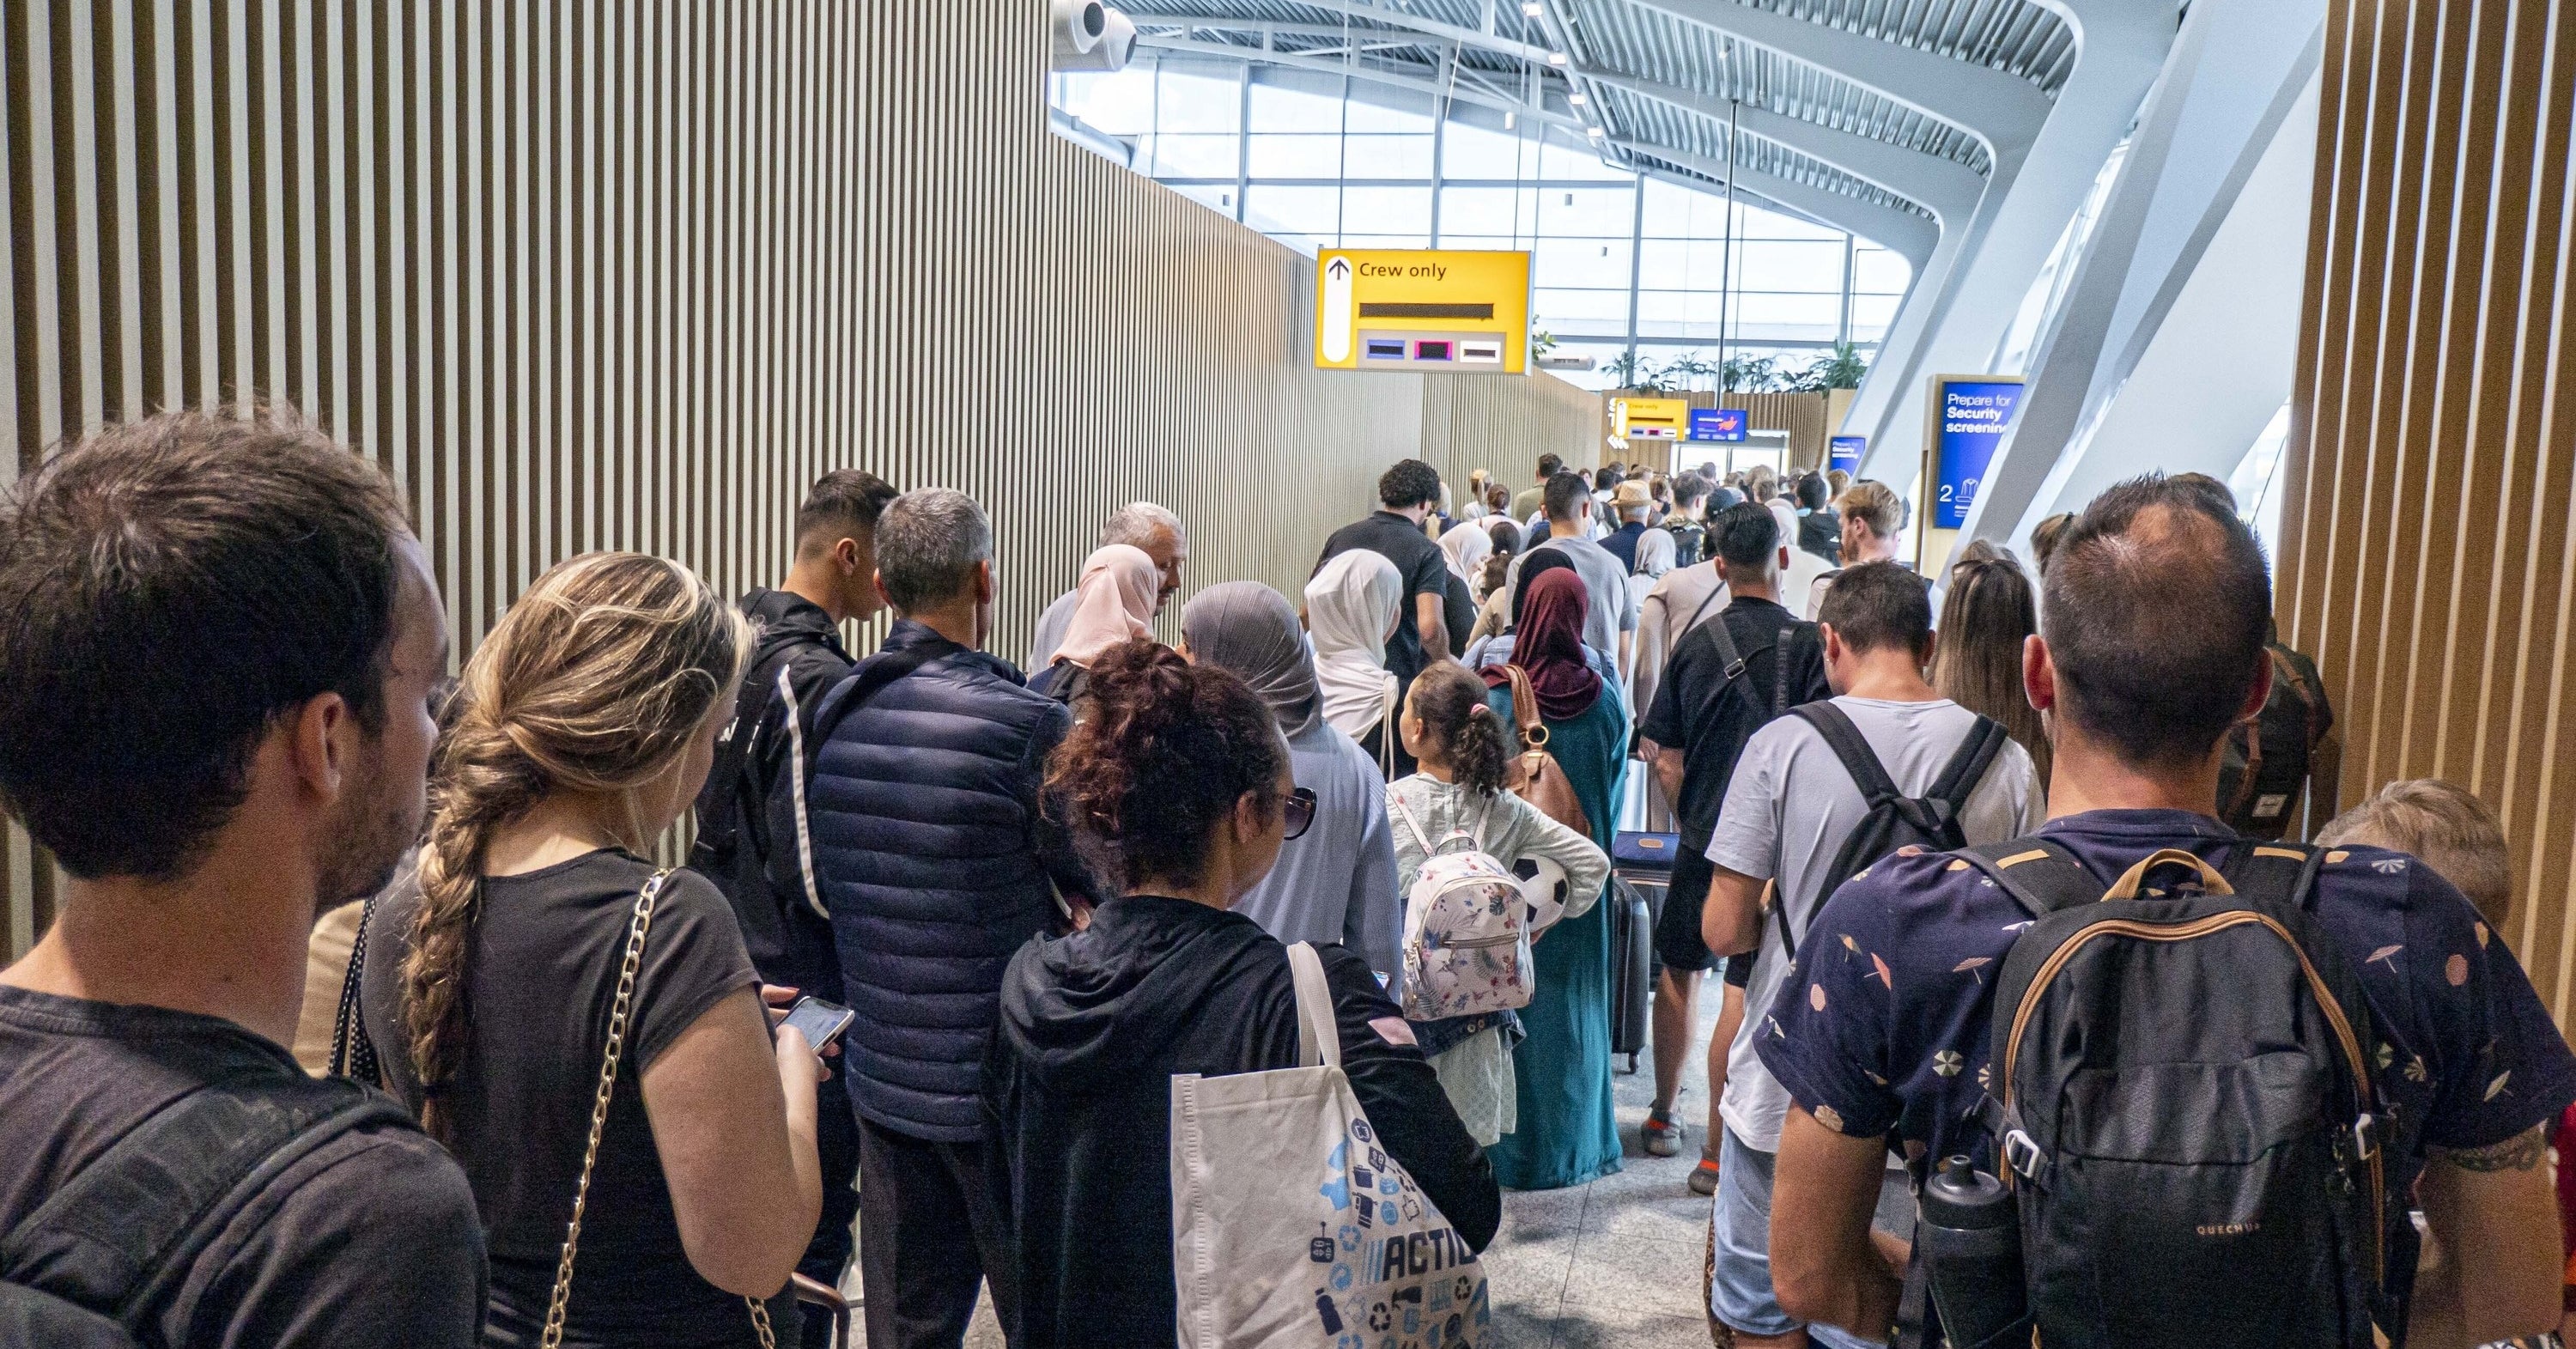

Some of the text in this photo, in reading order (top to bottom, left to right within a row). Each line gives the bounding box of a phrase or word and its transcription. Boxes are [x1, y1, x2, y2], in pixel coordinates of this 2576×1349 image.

[1359, 262, 1447, 282] Crew only
[1947, 392, 2011, 407] Prepare for
[1947, 406, 2002, 422] Security
[1939, 483, 1953, 503] 2
